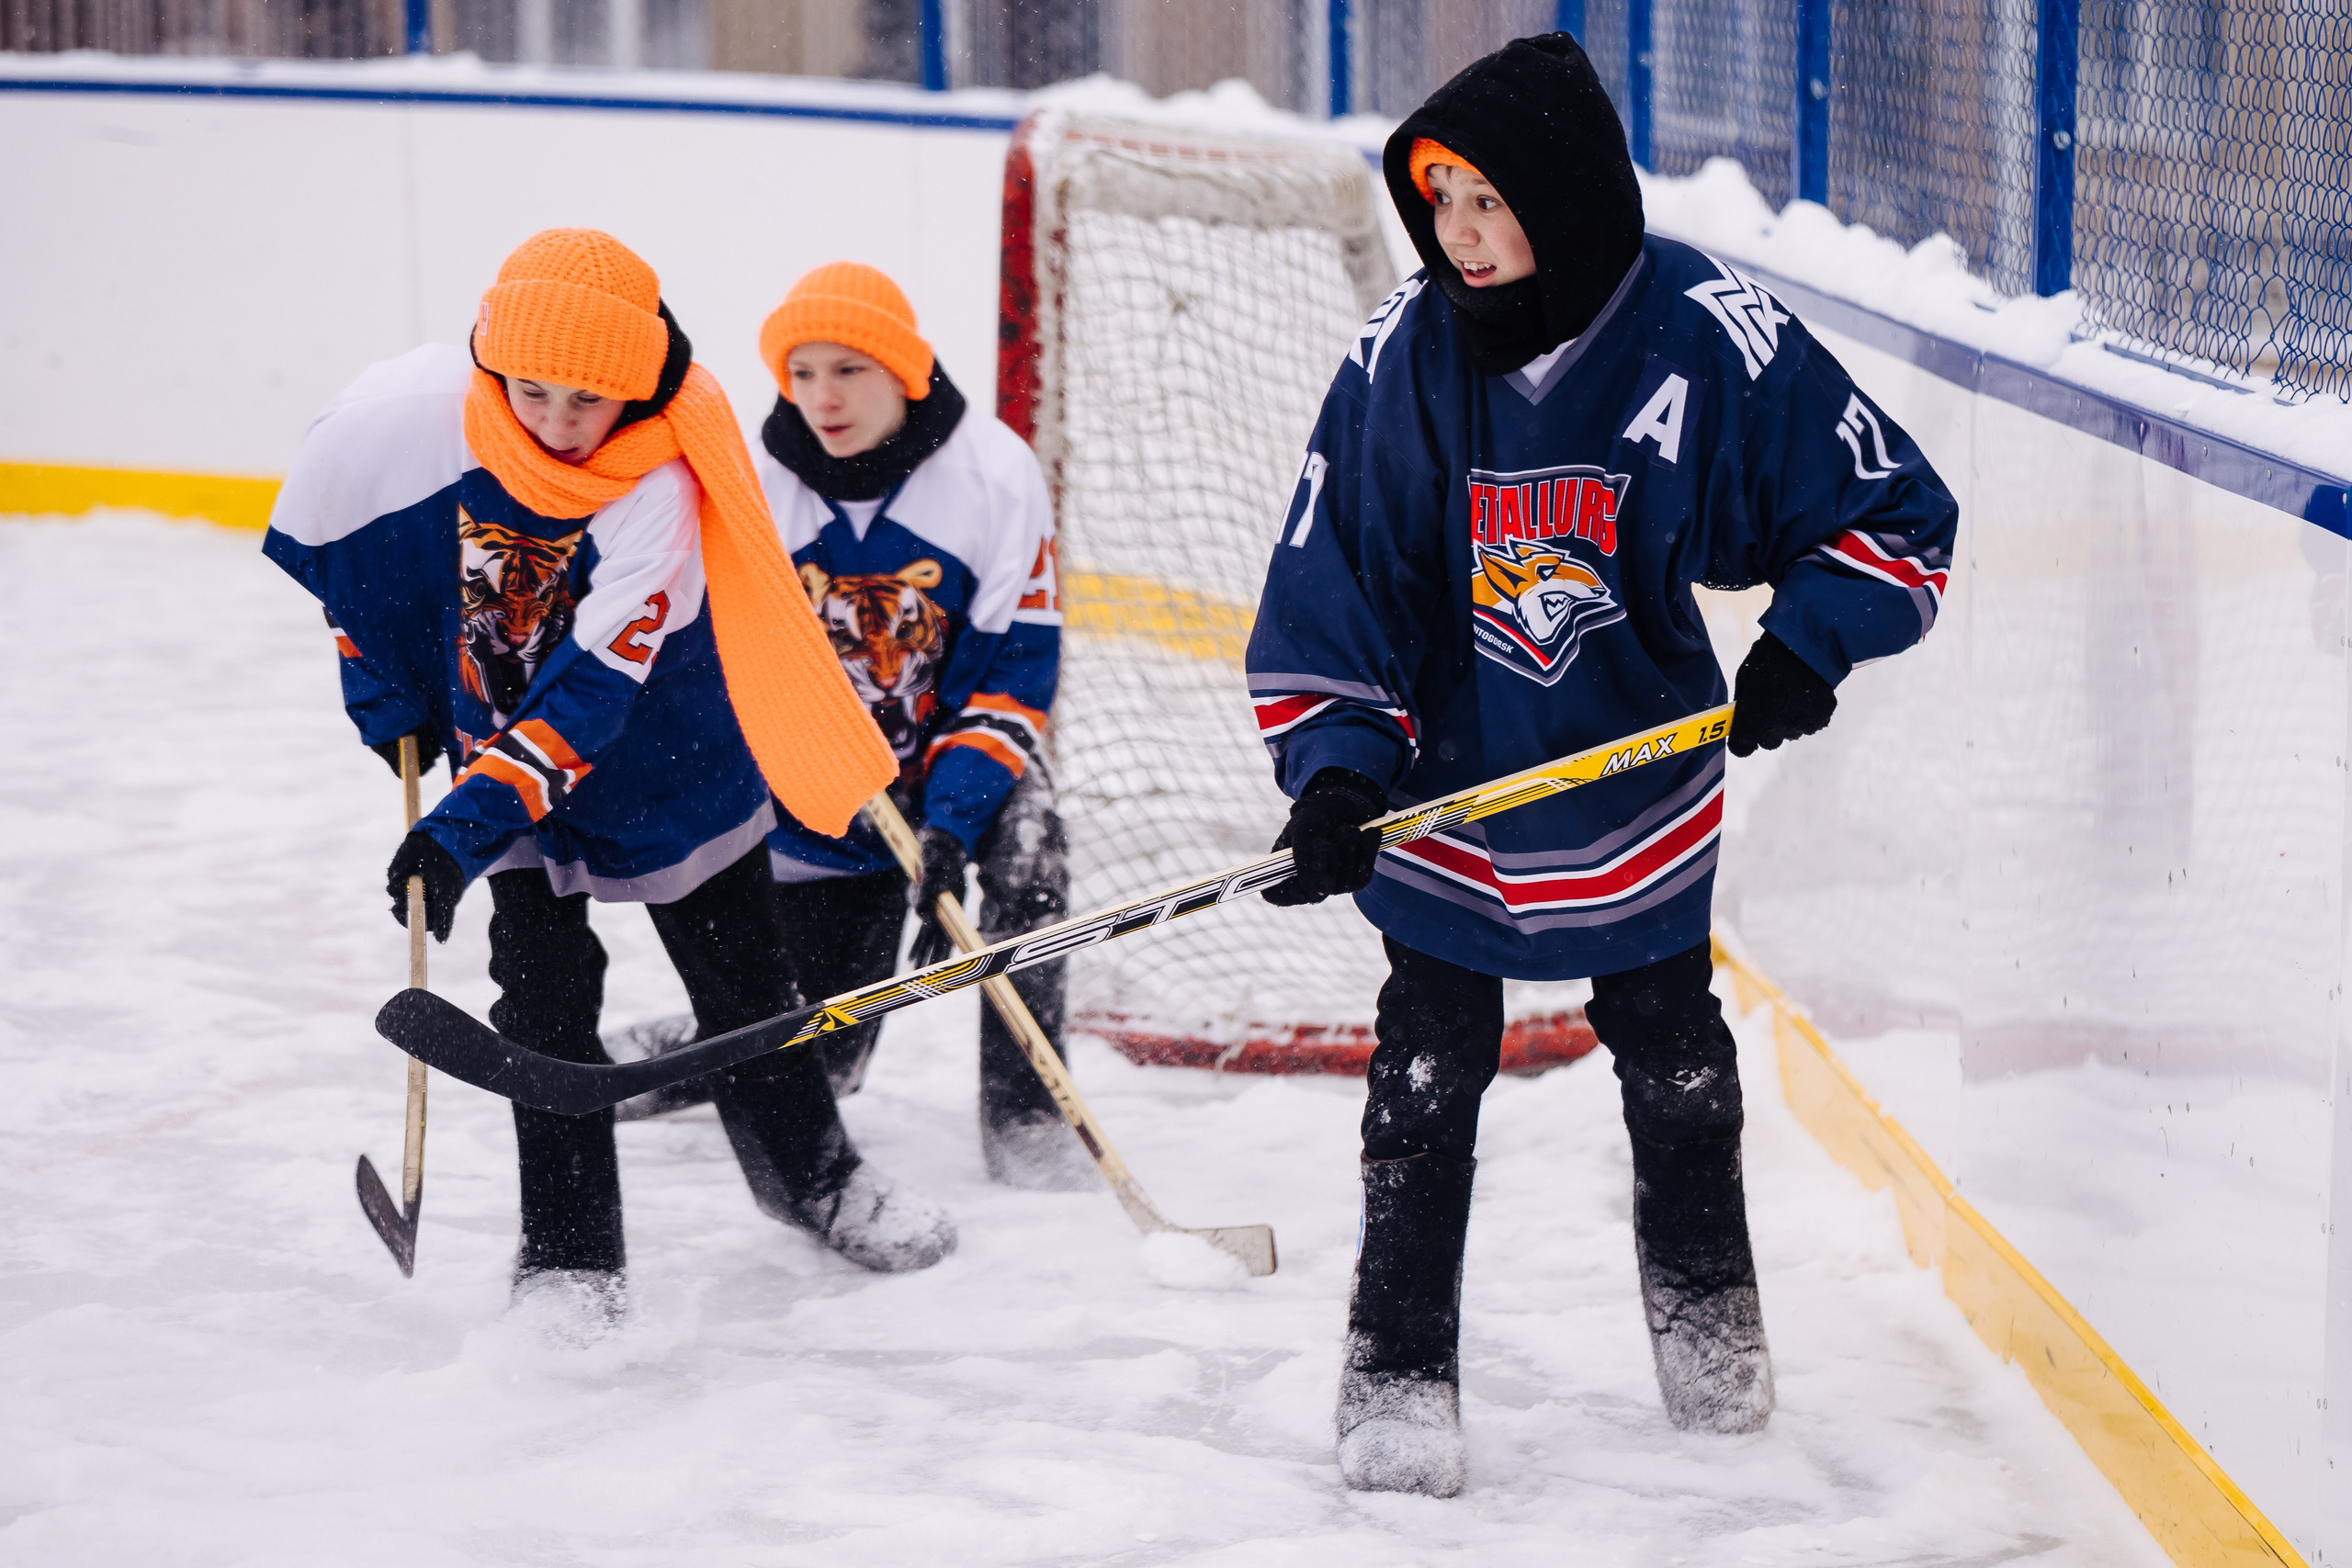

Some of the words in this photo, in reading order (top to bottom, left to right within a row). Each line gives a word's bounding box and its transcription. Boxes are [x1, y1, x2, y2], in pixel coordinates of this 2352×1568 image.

[1622, 372, 1689, 464] A
[1835, 390, 1904, 479] 17
[1470, 477, 1617, 557] ETALLURG
[606, 589, 672, 666] 2
[1473, 623, 1514, 654] NITOGORSK
[1599, 731, 1679, 778] MAX
[1698, 719, 1726, 744] 1.5
